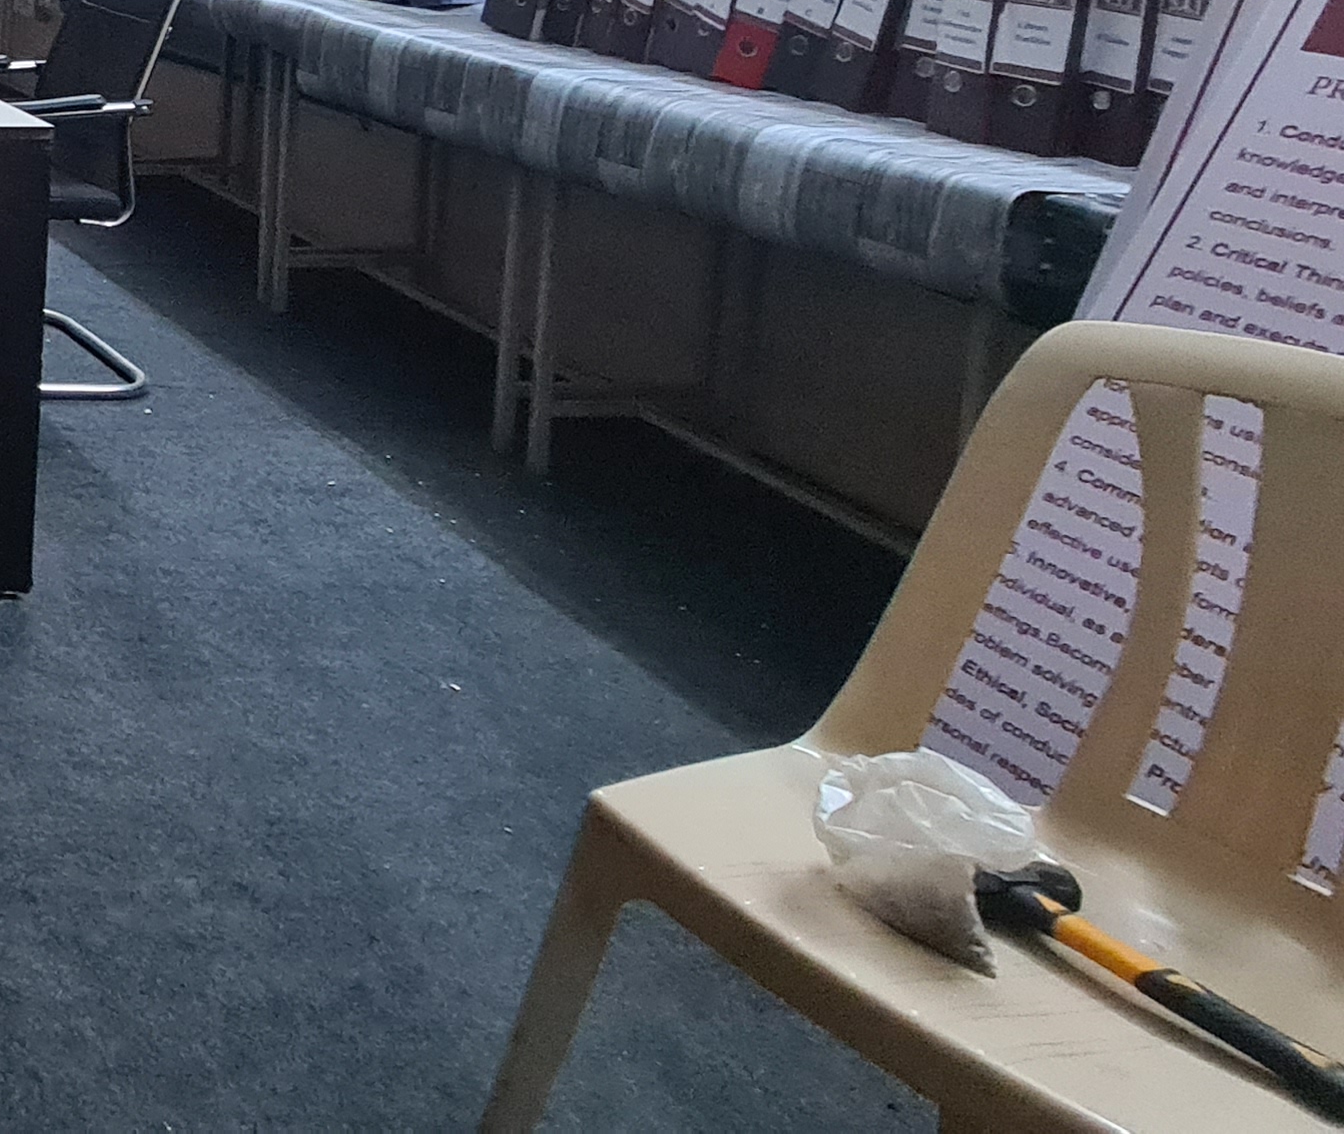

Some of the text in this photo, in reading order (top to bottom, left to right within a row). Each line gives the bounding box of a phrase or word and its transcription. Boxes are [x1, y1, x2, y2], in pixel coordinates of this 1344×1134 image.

[1224, 182, 1267, 199] and
[1209, 211, 1335, 251] conclusions.
[1210, 242, 1288, 274] Critical
[1149, 295, 1195, 315] plan
[1198, 309, 1242, 329] and
[1256, 288, 1326, 319] beliefs
[1042, 492, 1136, 537] advanced
[1027, 519, 1102, 559] effective
[1032, 663, 1099, 709] solving
